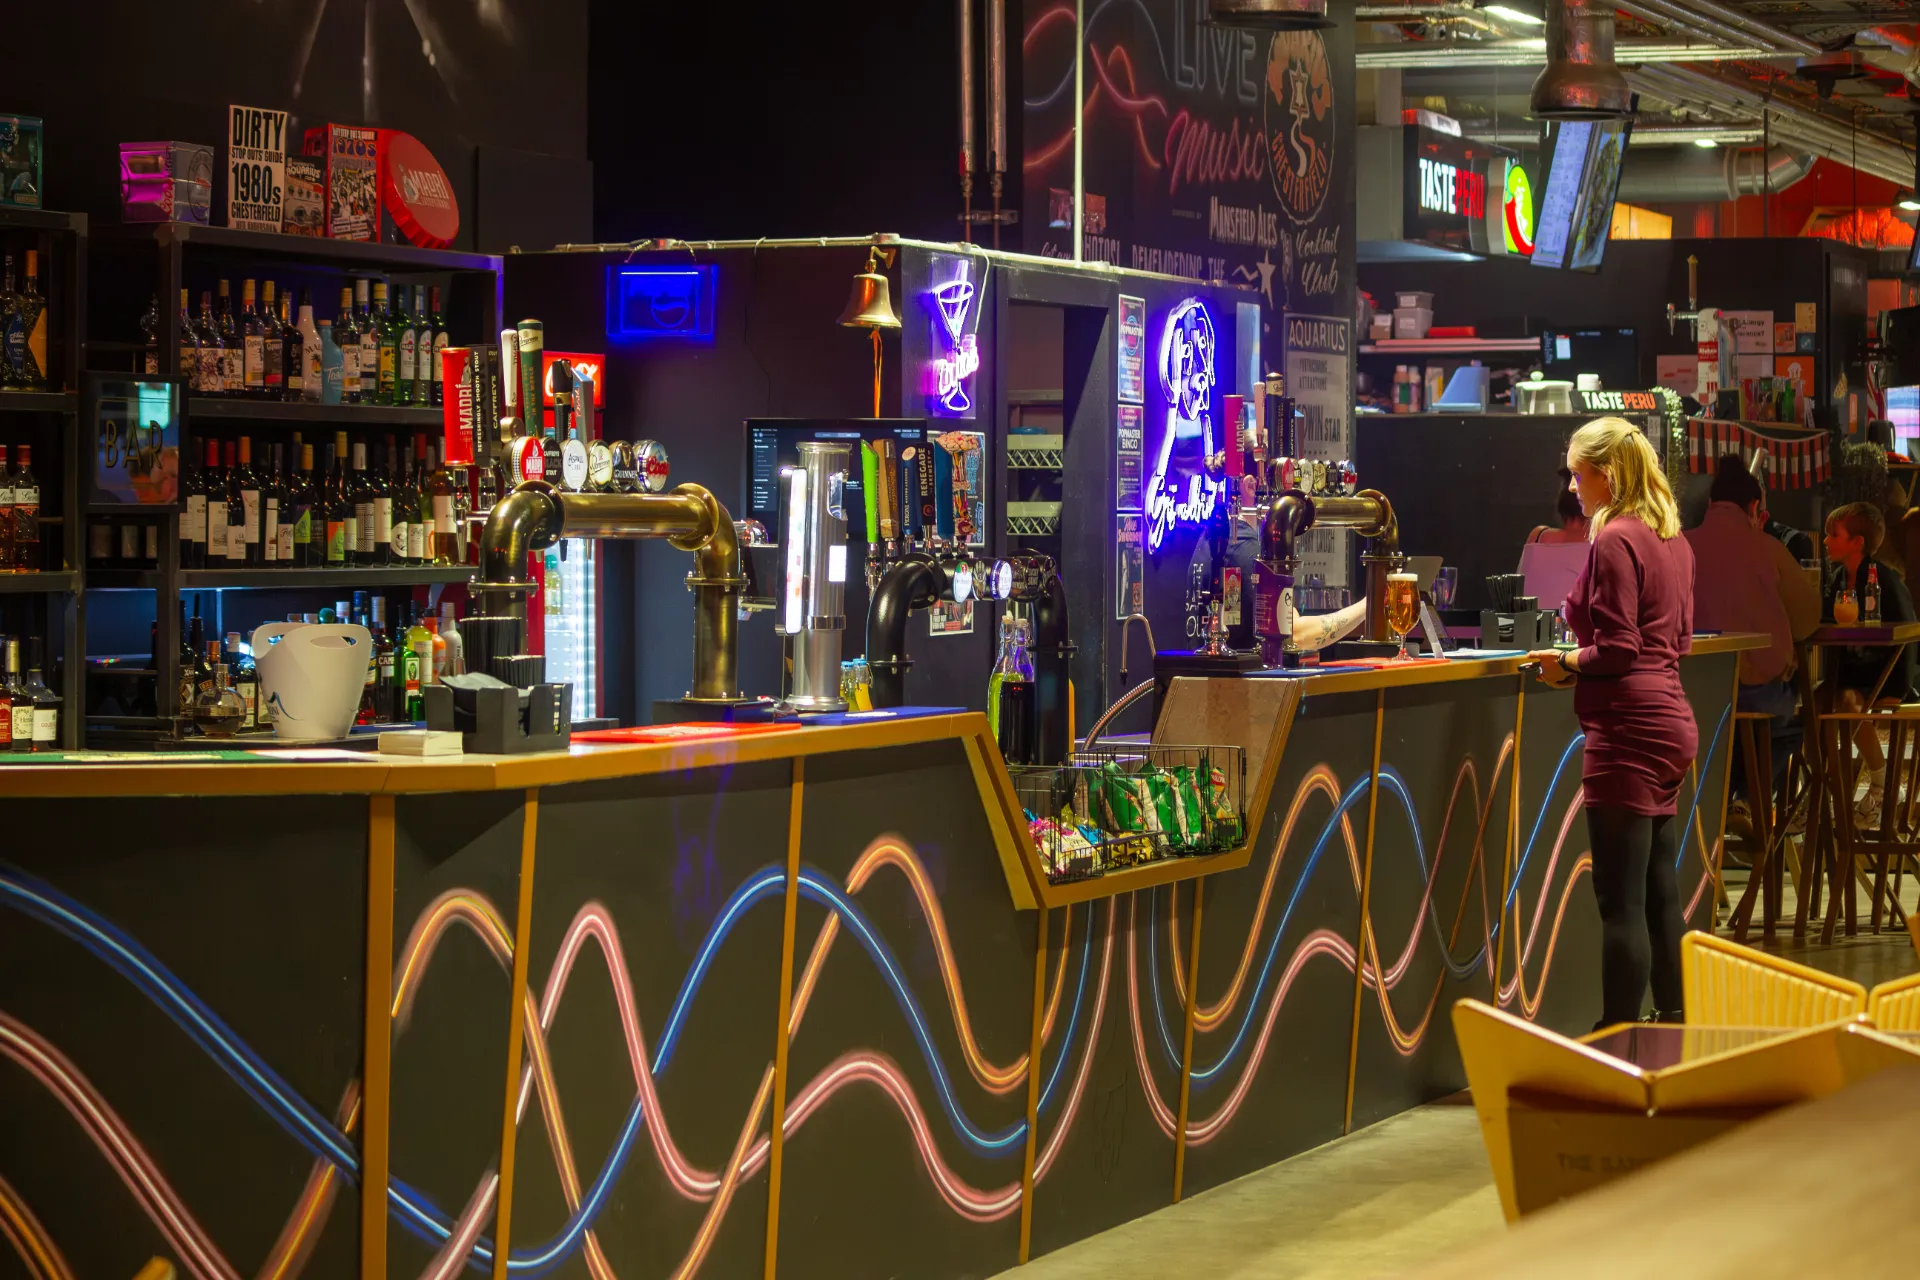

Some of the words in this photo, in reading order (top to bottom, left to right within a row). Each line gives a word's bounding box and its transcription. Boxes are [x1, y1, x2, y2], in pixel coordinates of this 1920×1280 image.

[233, 108, 285, 150] DIRTY
[231, 147, 246, 160] STOP
[264, 151, 283, 164] GUIDE
[1164, 110, 1265, 196] Music
[231, 201, 281, 222] CHESTERFIELD
[1257, 203, 1278, 248] ALES
[1301, 258, 1339, 297] Club
[1288, 319, 1346, 352] AQUARIUS
[103, 420, 163, 471] BAR
[1324, 416, 1342, 443] STAR
[917, 447, 929, 497] RENEGADE
